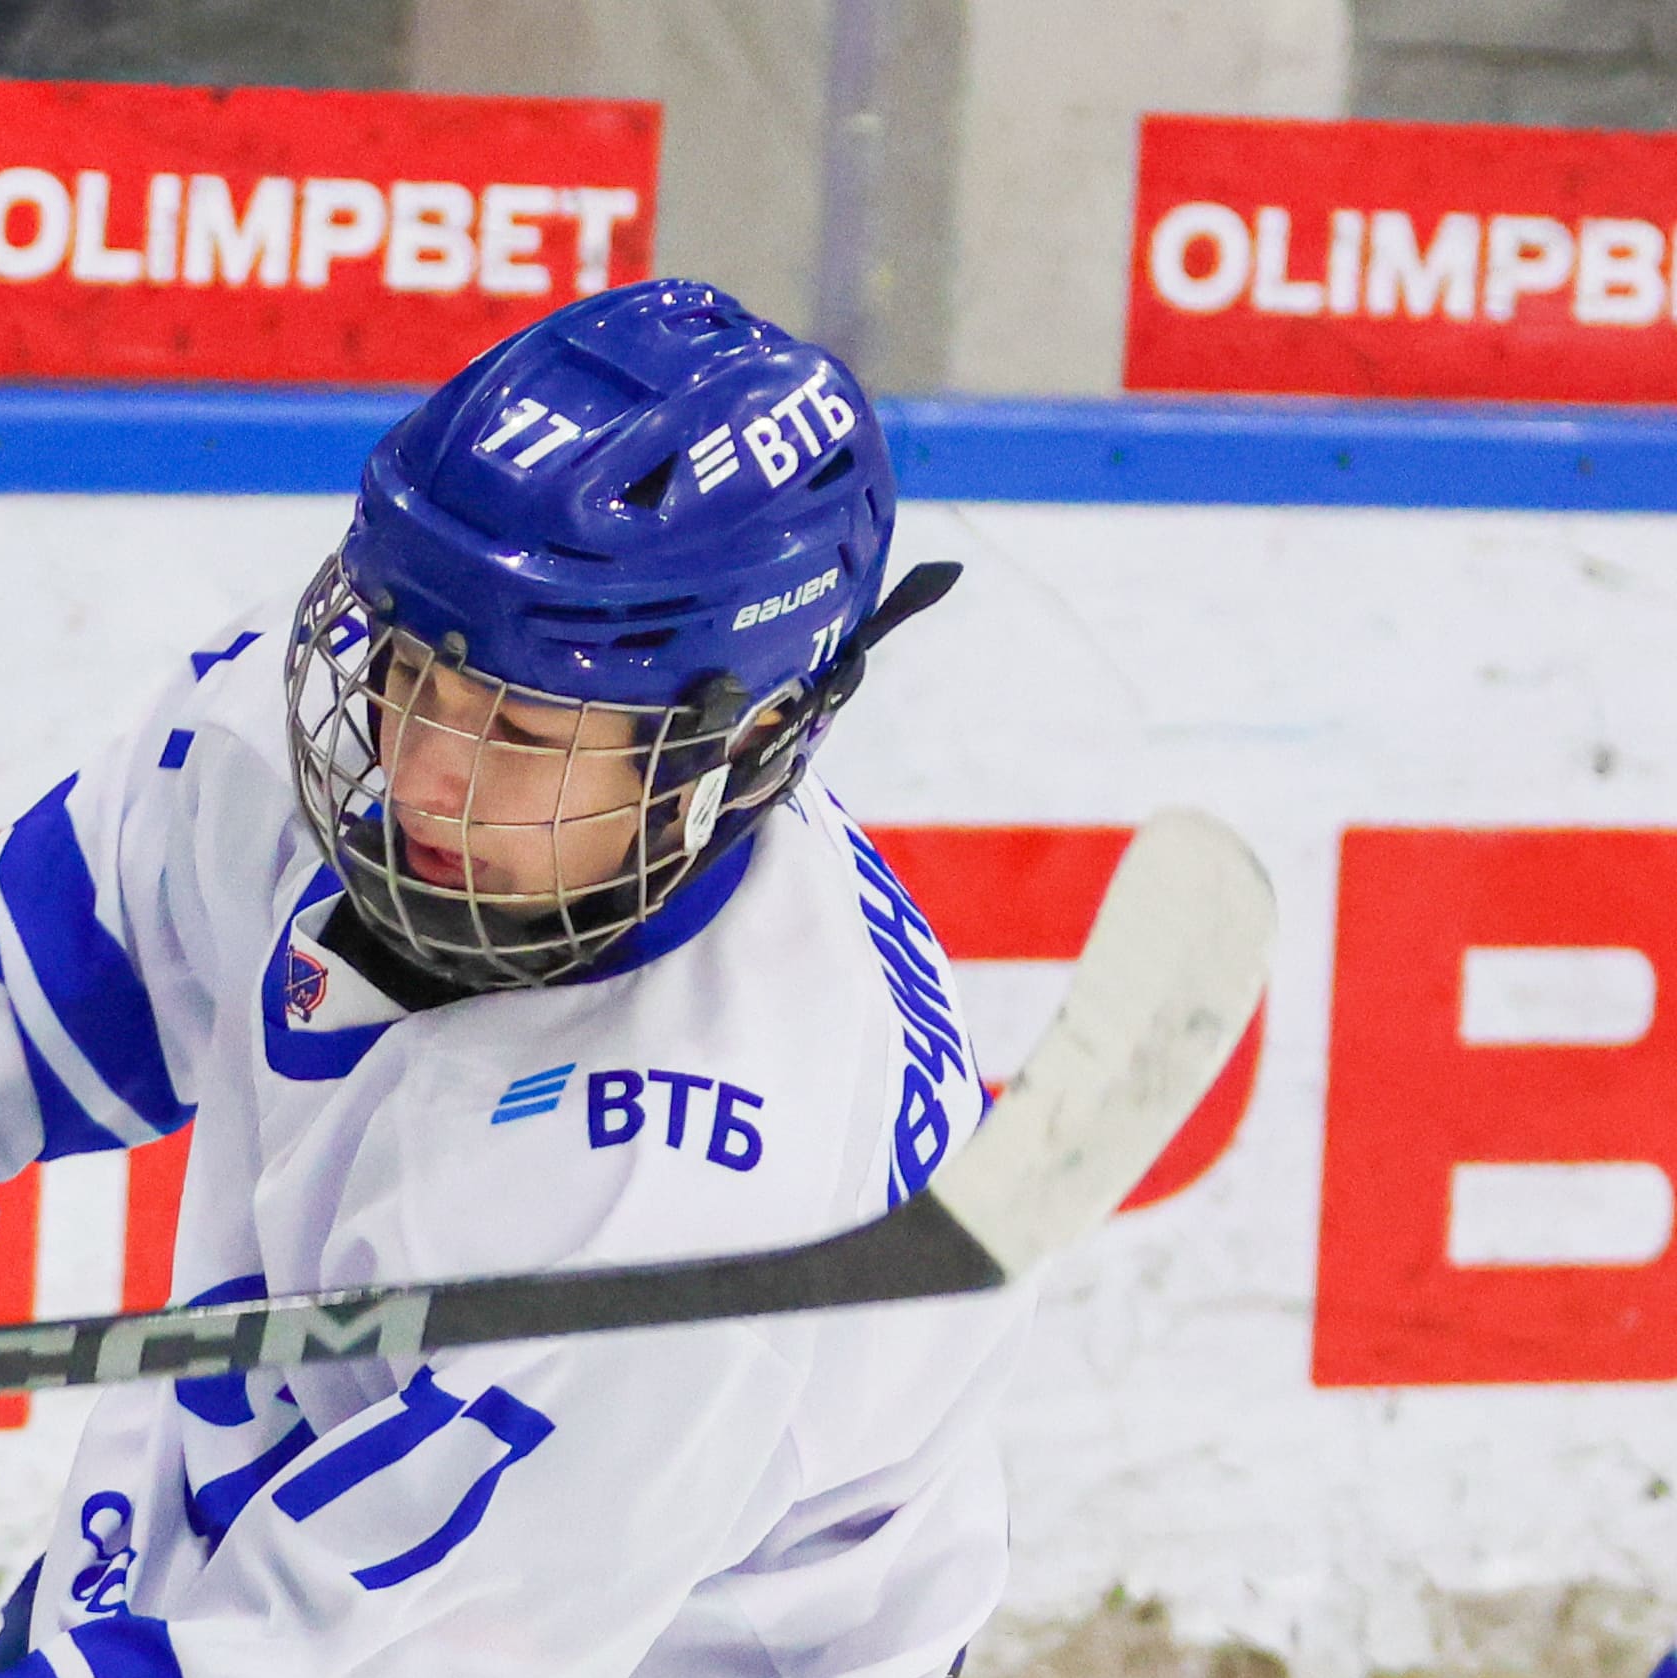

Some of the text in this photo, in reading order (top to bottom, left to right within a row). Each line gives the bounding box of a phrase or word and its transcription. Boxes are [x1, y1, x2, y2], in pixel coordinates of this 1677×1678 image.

[1149, 200, 1677, 329] OLIMPB
[743, 366, 857, 489] ВТБ
[587, 1068, 764, 1173] ВТБ
